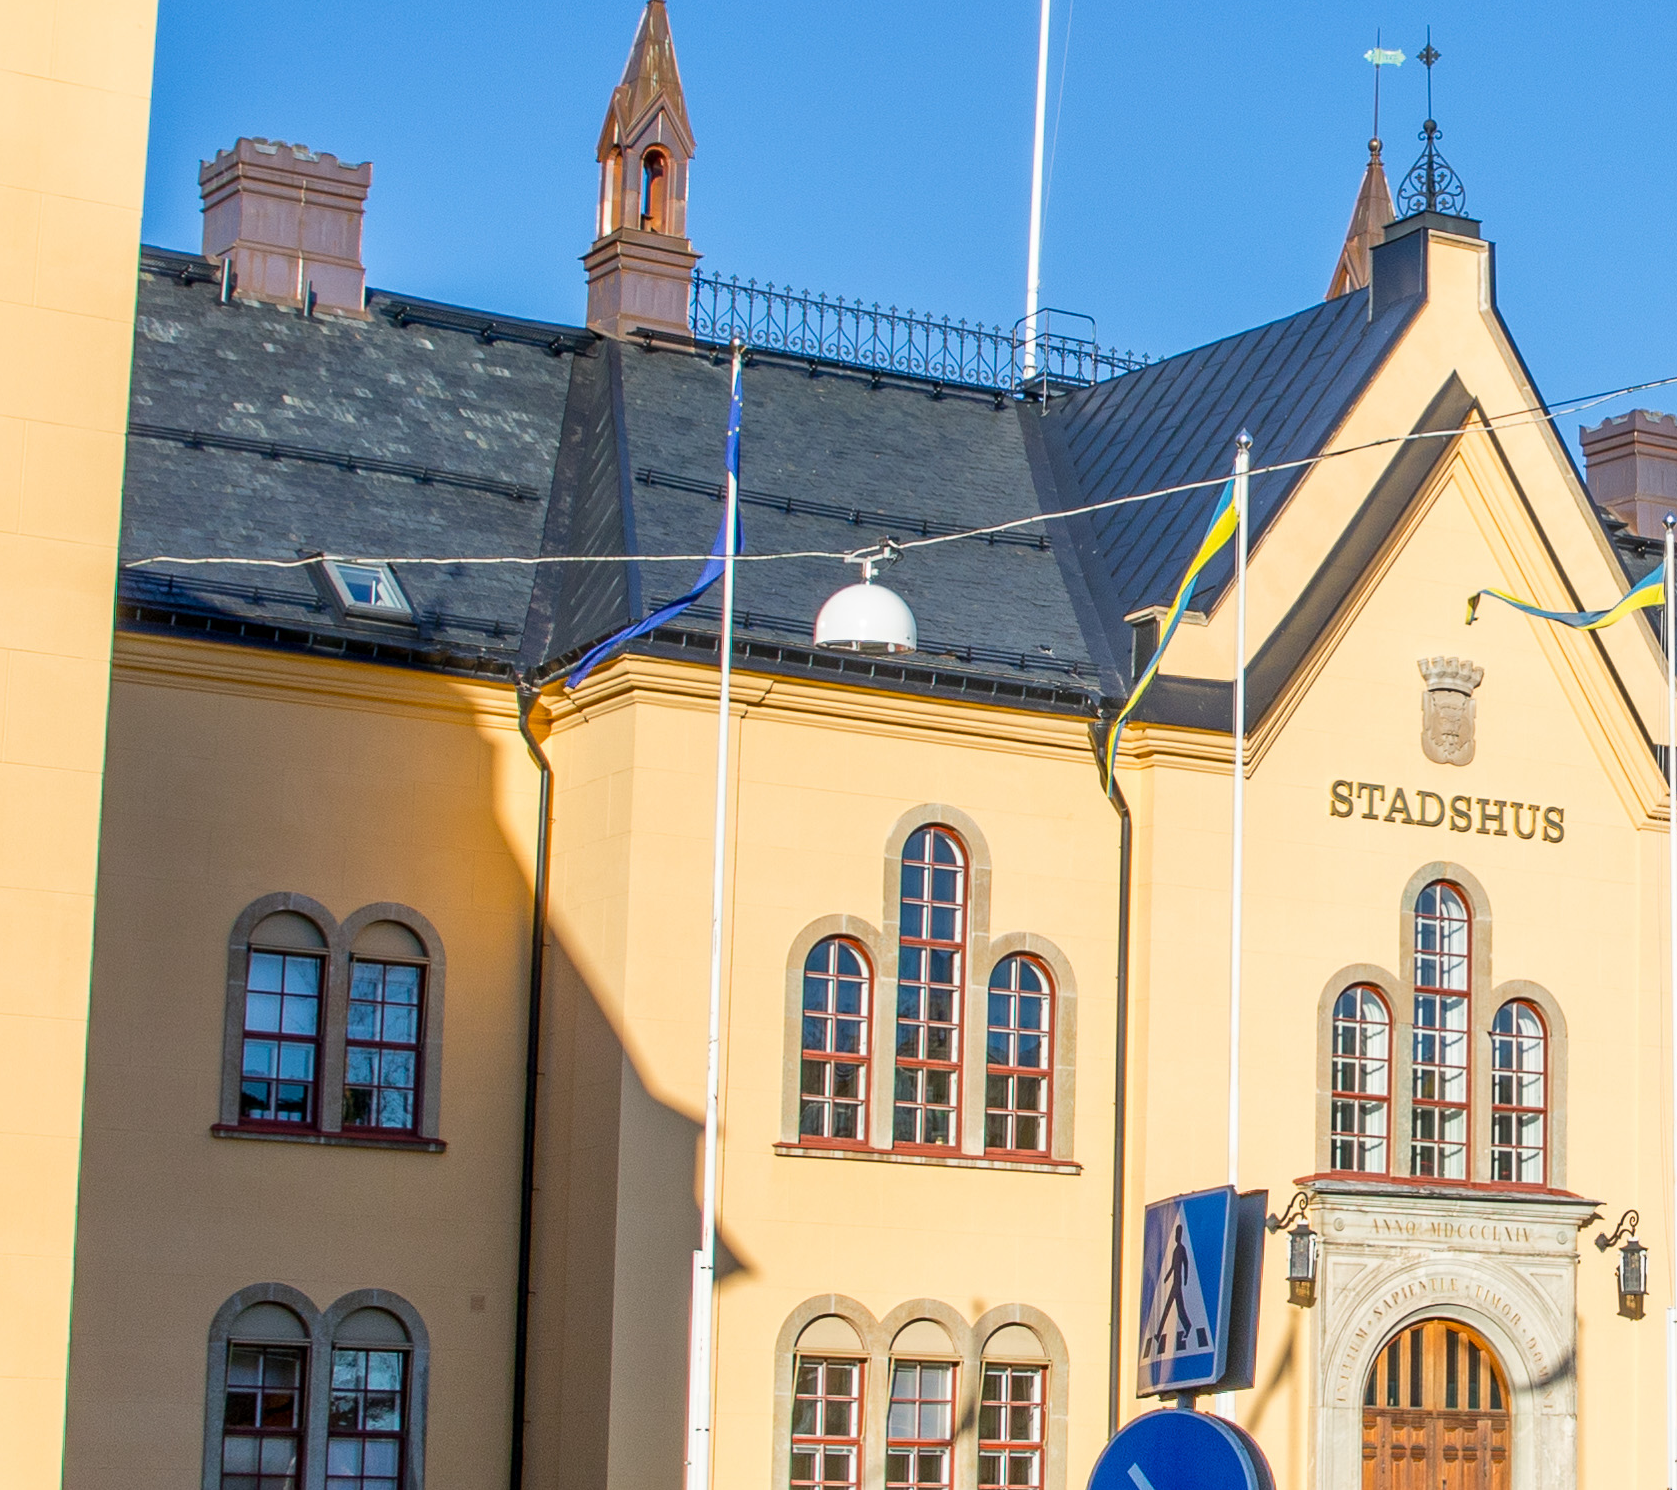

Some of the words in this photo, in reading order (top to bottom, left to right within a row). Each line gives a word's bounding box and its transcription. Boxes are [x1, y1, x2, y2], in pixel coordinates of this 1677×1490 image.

[1329, 780, 1565, 843] STADSHUS
[1370, 1218, 1416, 1236] ANNO
[1430, 1222, 1533, 1242] MDCCCLXIV
[1475, 1284, 1522, 1326] TIMOR
